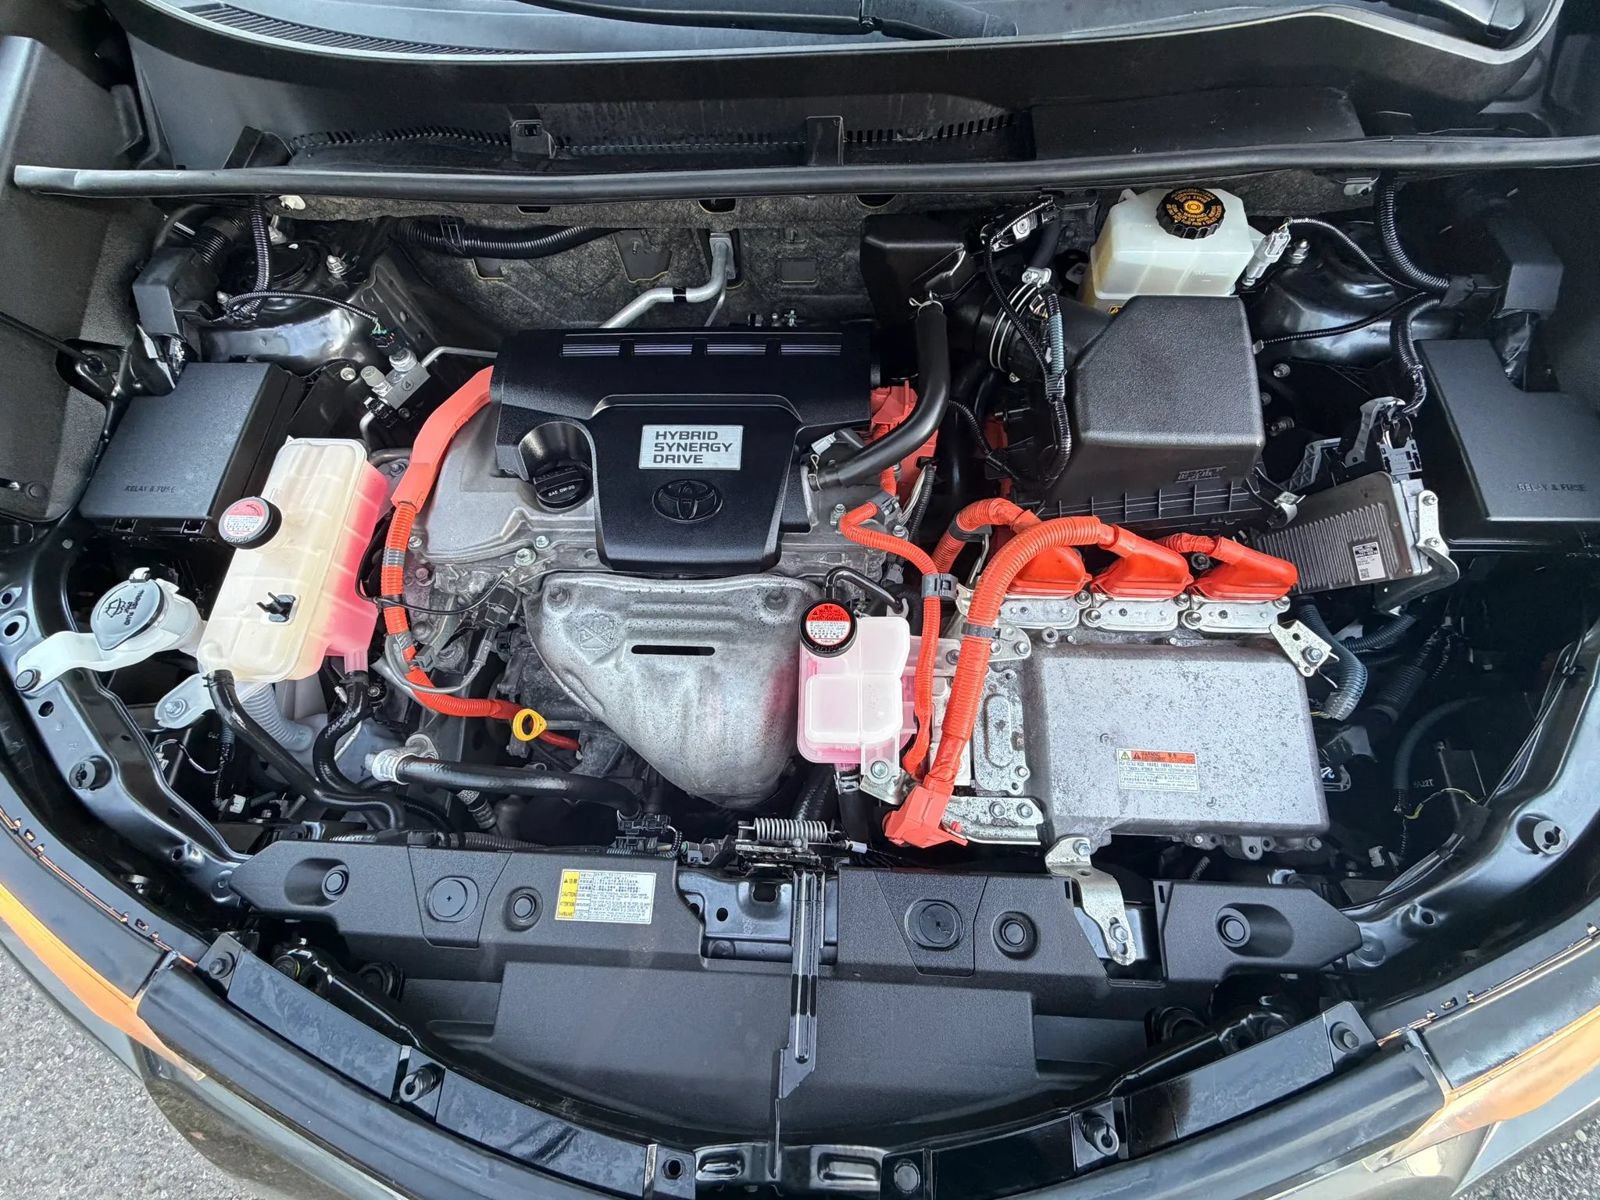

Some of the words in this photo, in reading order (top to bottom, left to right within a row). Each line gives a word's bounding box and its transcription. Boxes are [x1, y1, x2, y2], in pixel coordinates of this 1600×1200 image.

[655, 431, 718, 440] HYBRID
[654, 443, 733, 452] SYNERGY
[653, 454, 704, 464] DRIVE
